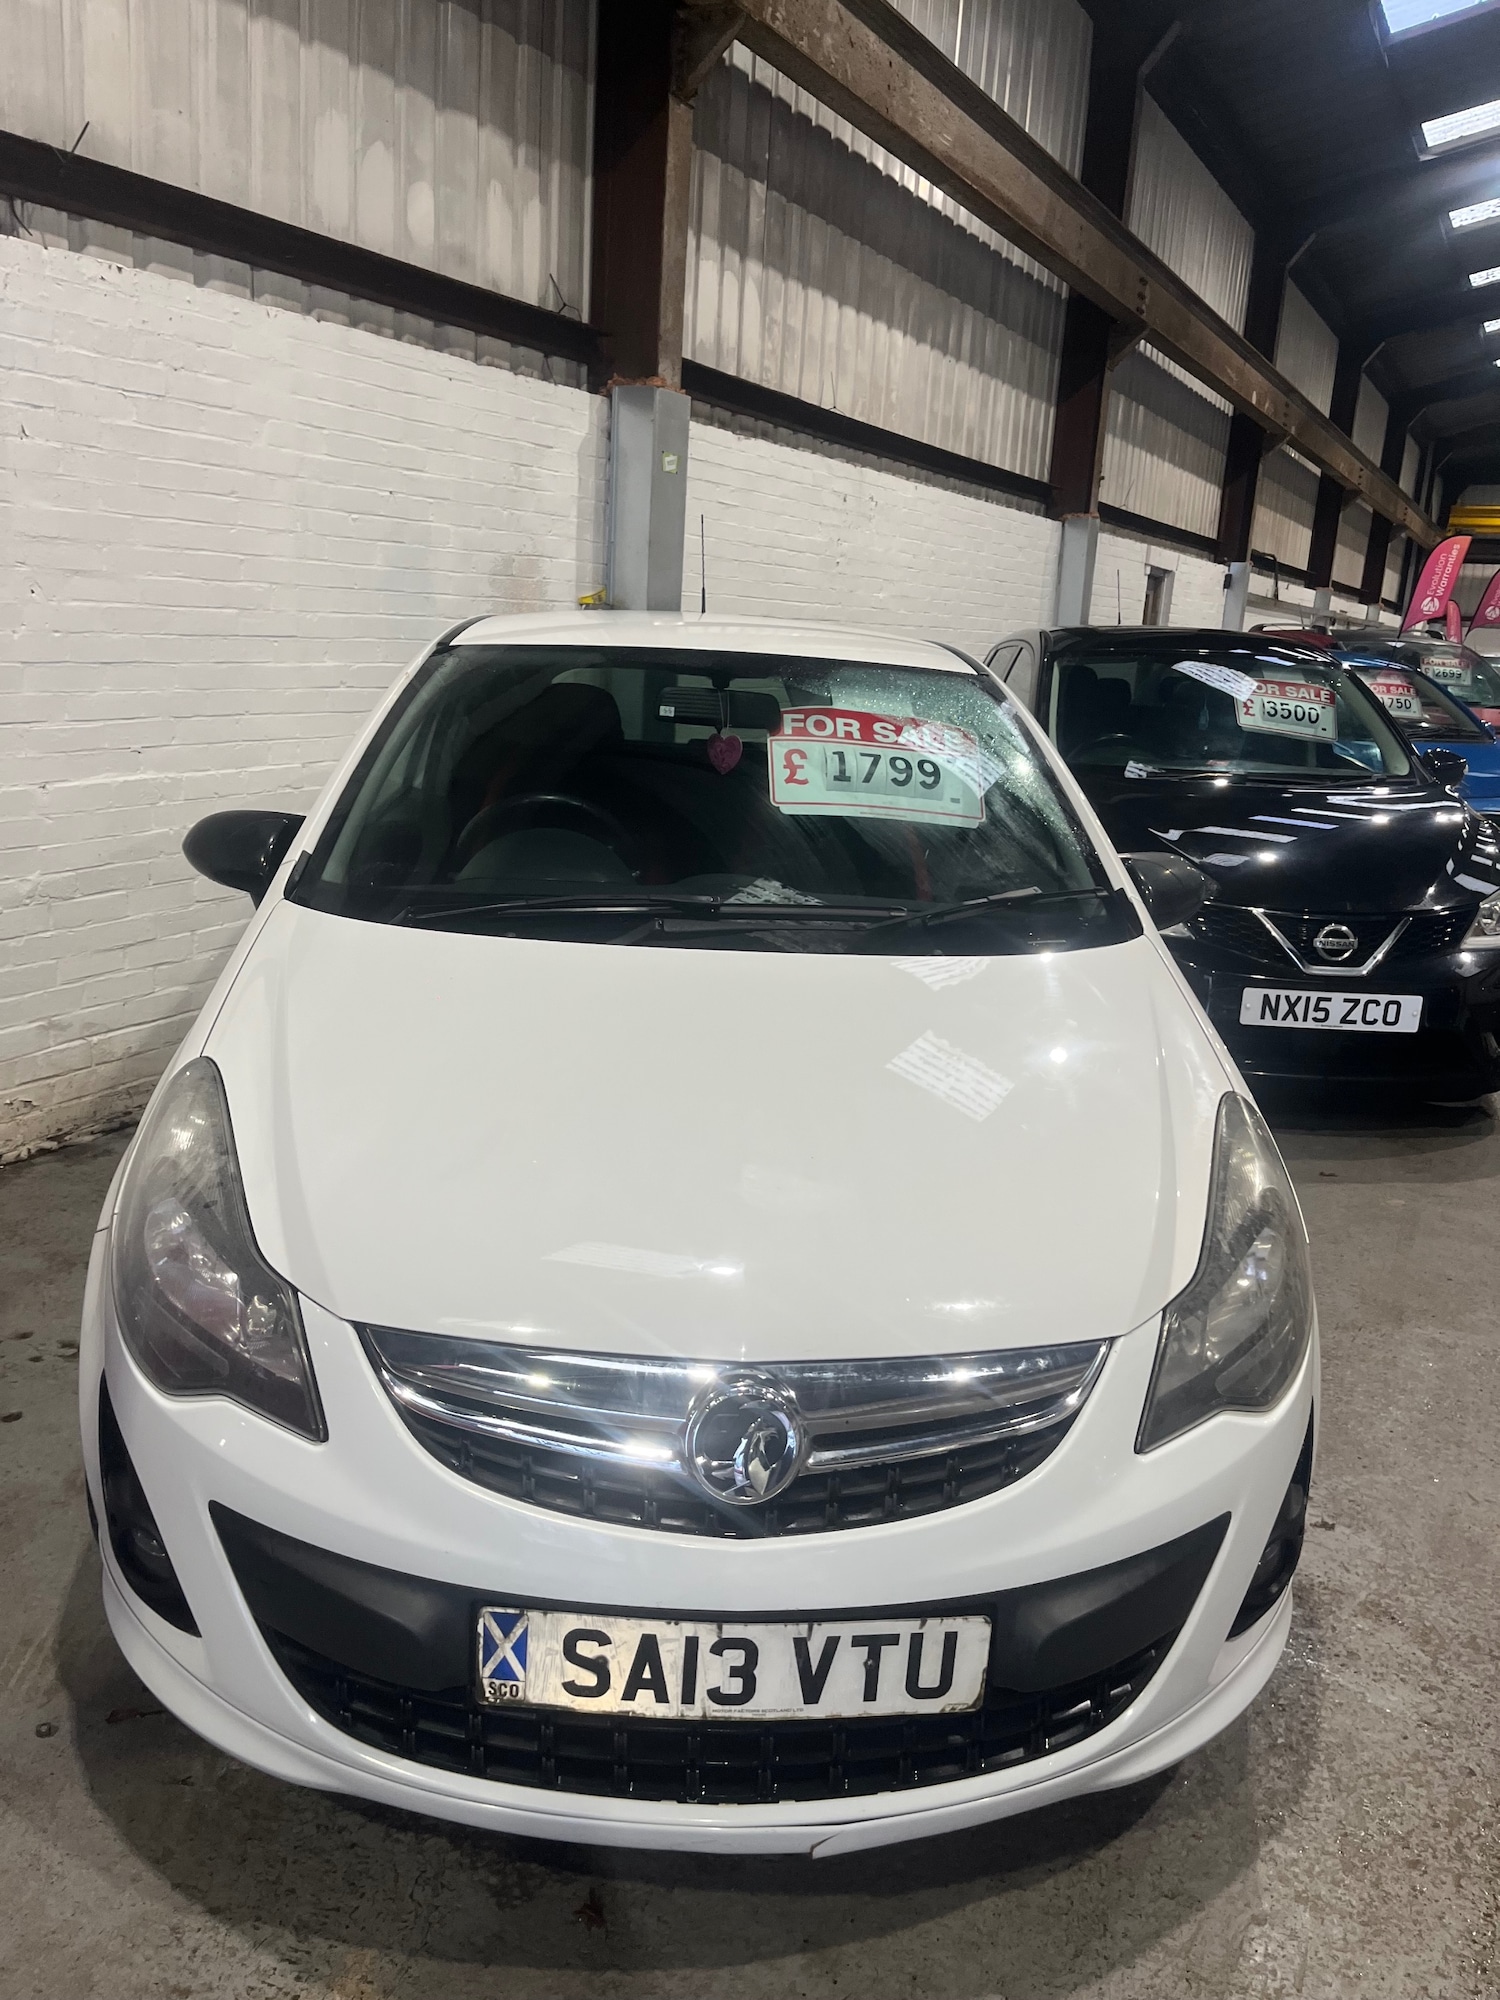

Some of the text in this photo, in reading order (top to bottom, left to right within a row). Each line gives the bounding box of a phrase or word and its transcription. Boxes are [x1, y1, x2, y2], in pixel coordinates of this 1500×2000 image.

[1427, 553, 1447, 595] Evolution
[1435, 544, 1460, 596] Warranties
[1255, 682, 1330, 703] OR SALE
[1369, 685, 1416, 695] OR SALE
[1242, 699, 1319, 724] £ 3500
[783, 714, 861, 739] FOR
[783, 748, 941, 790] £ 1799
[1319, 940, 1355, 948] NISSAN
[1260, 993, 1402, 1026] NX15 ZCO
[561, 1629, 959, 1706] SA13 VTU
[488, 1681, 520, 1699] SCO
